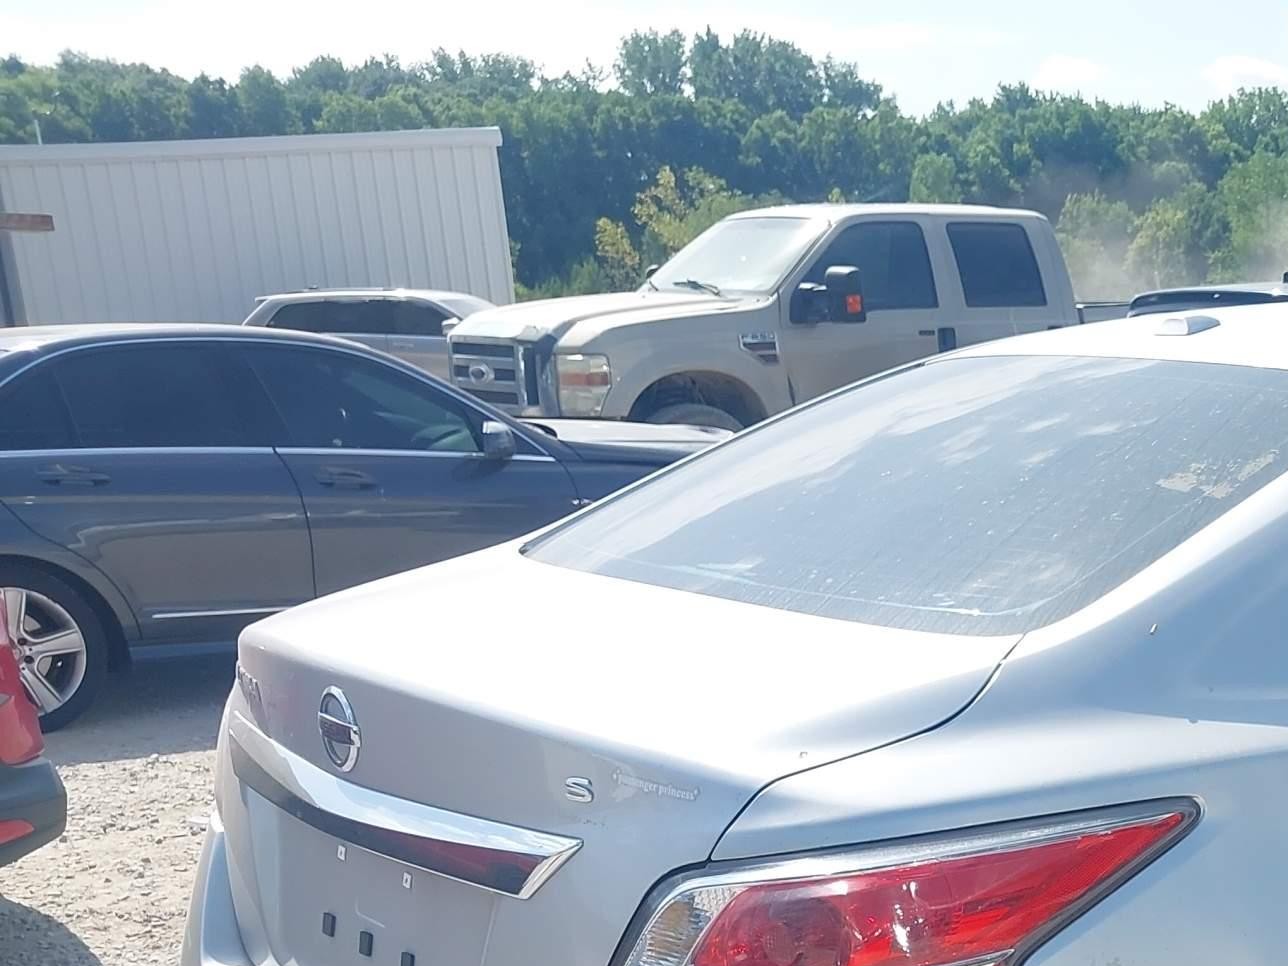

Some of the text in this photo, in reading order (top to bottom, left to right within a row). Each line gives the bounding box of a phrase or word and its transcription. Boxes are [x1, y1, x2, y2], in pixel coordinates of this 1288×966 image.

[565, 776, 594, 803] S
[617, 773, 695, 801] pnger princess
